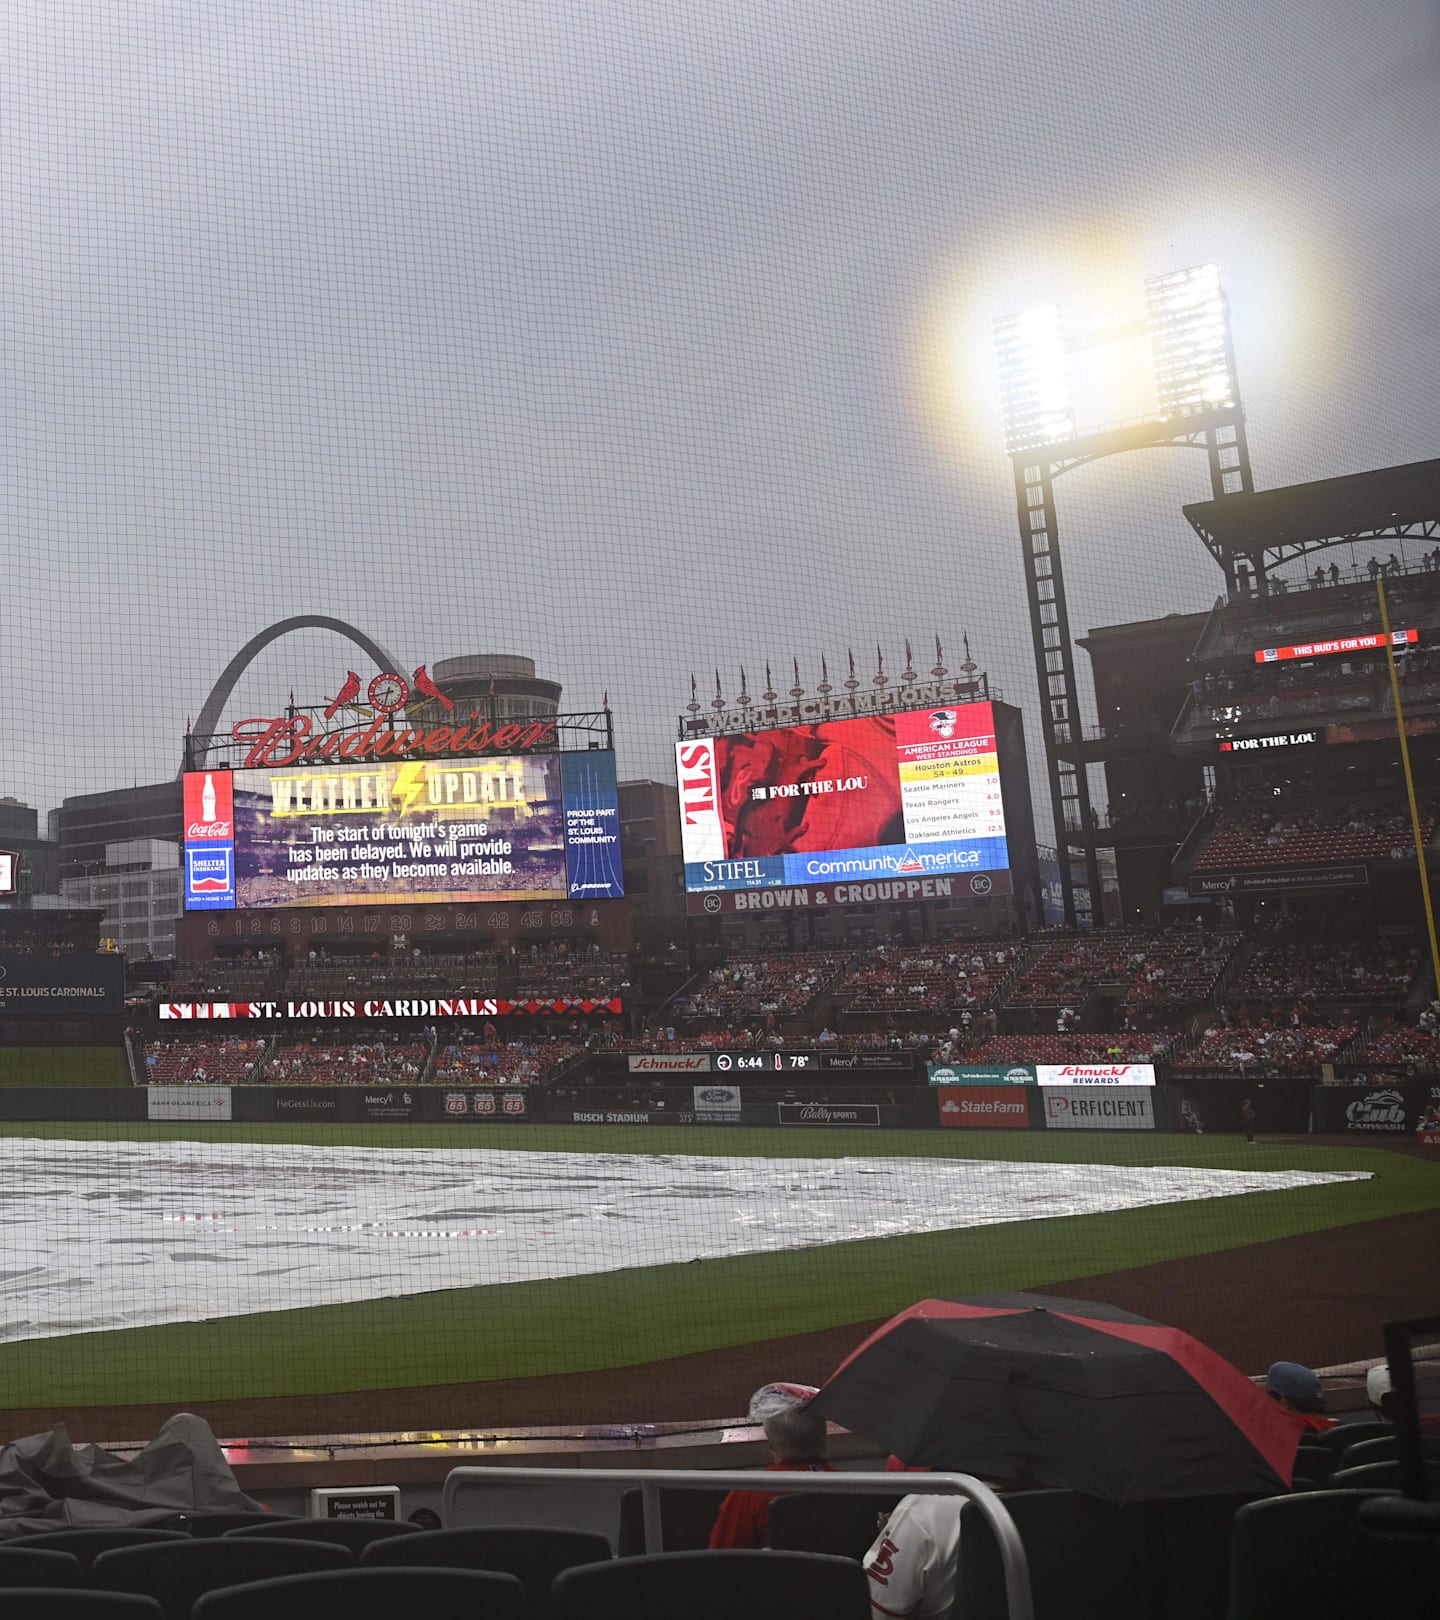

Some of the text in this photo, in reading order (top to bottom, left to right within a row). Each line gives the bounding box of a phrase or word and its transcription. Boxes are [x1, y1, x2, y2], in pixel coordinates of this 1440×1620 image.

[1293, 637, 1376, 655] THIS BUD'S FOR YOU
[706, 683, 955, 729] WORLD CHAMPIONS
[232, 711, 556, 769] Budweiser
[1232, 732, 1317, 751] FOR THE LOU
[904, 739, 989, 755] AMERICAN LEAGUE
[937, 748, 978, 758] STANDINGS
[915, 758, 981, 772] Houston Astros
[270, 771, 525, 814] WEATHER UPDATE
[769, 784, 800, 799] FOR
[800, 780, 834, 795] THE
[836, 776, 868, 791] LOU
[904, 781, 966, 793] Seattle Mariners
[928, 798, 959, 808] Rangers
[566, 810, 595, 818] PROUD
[921, 814, 951, 824] Angeles
[953, 811, 979, 821] Angels
[567, 818, 595, 827] OF THE
[310, 822, 488, 843] The start of tonight's game
[580, 827, 604, 835] LOUIS
[908, 827, 976, 839] Oakland Athletics
[568, 835, 617, 844] COMMUNITY
[288, 838, 512, 864] has been delayed. We will provide
[193, 859, 225, 867] SHELTER
[287, 859, 516, 884] updates as they become available.
[703, 860, 766, 882] STIFEL
[1201, 880, 1230, 890] Mercy
[734, 878, 952, 910] BROWN & CROUPPEN
[236, 910, 573, 935] 1 2 9 10 14 17 20 23 24 42 45 85
[6, 987, 20, 997] ST.
[21, 987, 50, 997] LOUIS
[50, 987, 106, 997] CARDINALS
[248, 998, 498, 1018] ST. LOUIS CARDINALS
[633, 1057, 707, 1069] Schnucks
[737, 1056, 763, 1068] 6:44
[830, 1058, 853, 1068] Mercy
[1057, 1066, 1132, 1077] Schnucks
[365, 1095, 389, 1106] Mercy
[705, 1090, 728, 1101] Ford
[449, 1101, 492, 1110] 66 66
[1048, 1096, 1146, 1118] PERFICIENT
[573, 1112, 649, 1123] BUSCH STADIUM
[800, 1106, 857, 1122] Bally SPORTS
